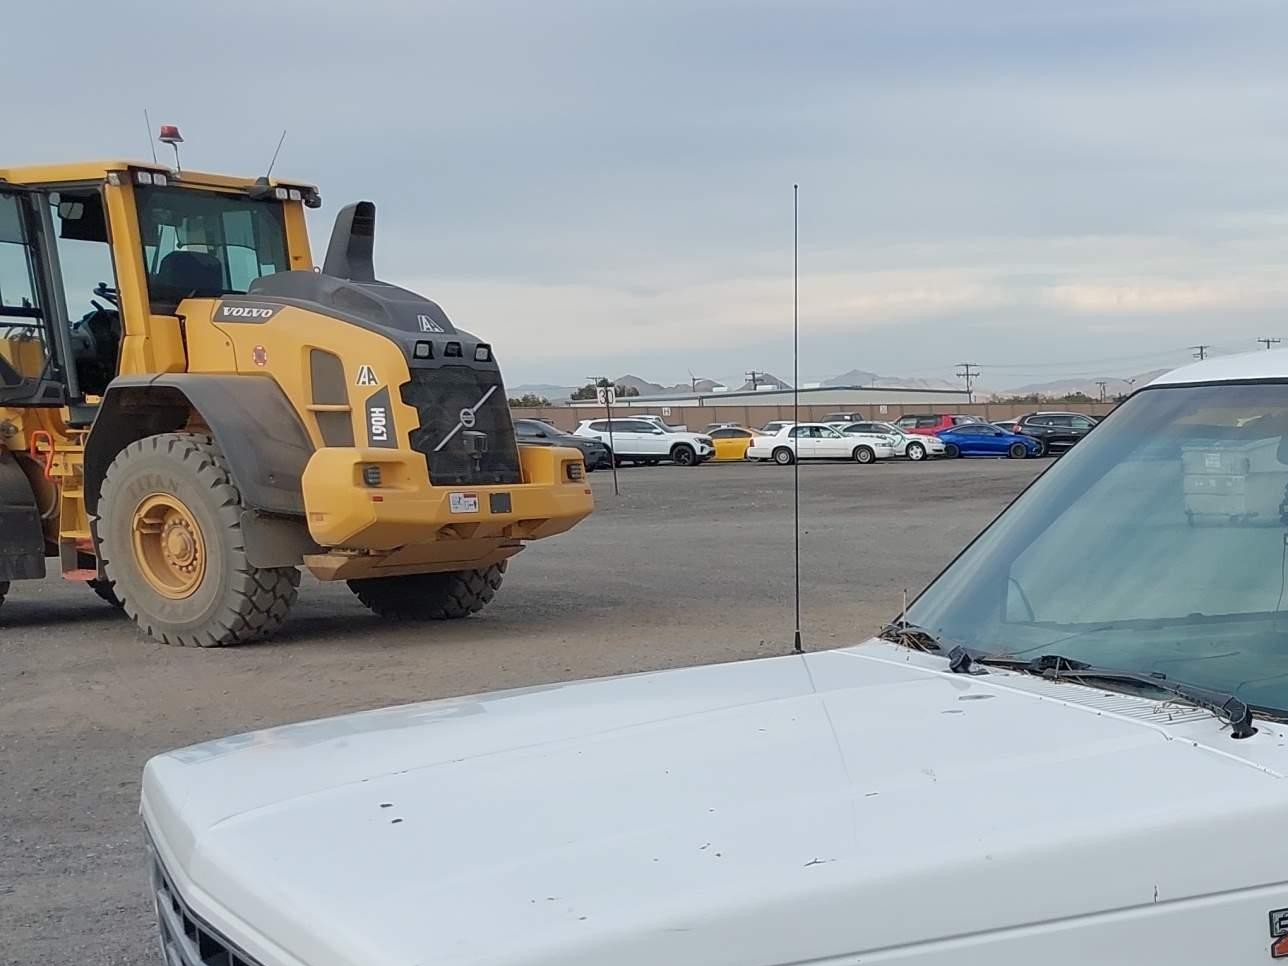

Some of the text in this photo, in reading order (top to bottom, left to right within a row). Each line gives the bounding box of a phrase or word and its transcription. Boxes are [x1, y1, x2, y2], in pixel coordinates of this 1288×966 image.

[223, 306, 273, 319] VOLVO
[598, 388, 614, 405] 30
[370, 407, 388, 441] L90H
